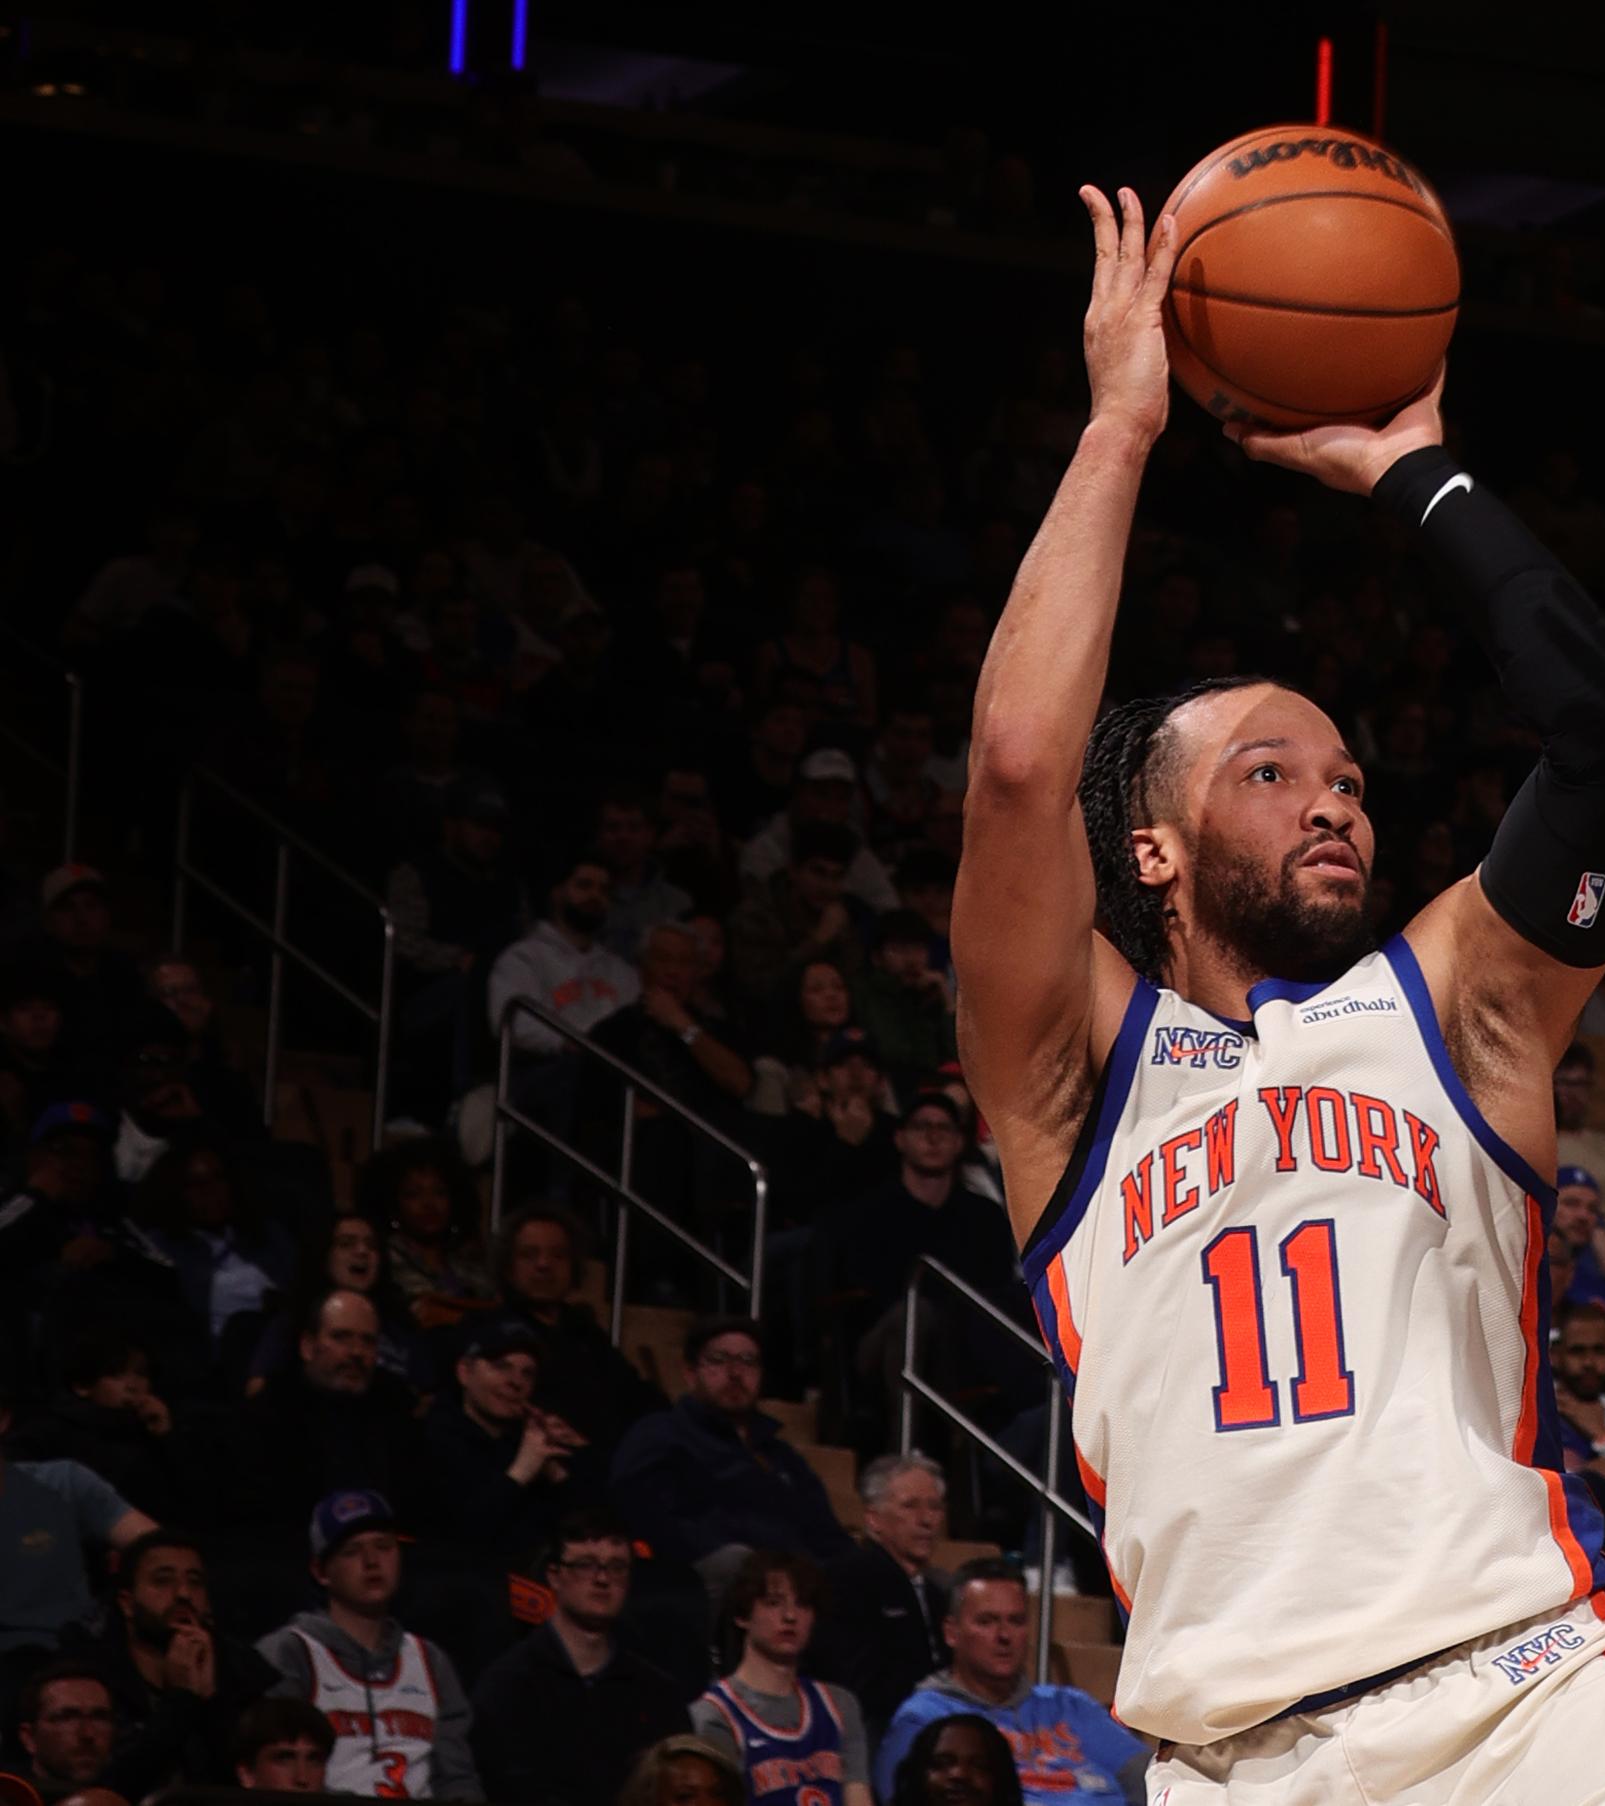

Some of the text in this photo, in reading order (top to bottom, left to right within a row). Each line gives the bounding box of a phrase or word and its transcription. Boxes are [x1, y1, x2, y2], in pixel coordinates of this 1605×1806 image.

[1303, 997, 1398, 1025] abu dhabi
[1151, 1027, 1244, 1069] NYC
[1120, 1085, 1449, 1267] NEW YORK
[1201, 1218, 1355, 1433] 11
[1491, 1623, 1585, 1686] NYC
[372, 1751, 409, 1800] 3
